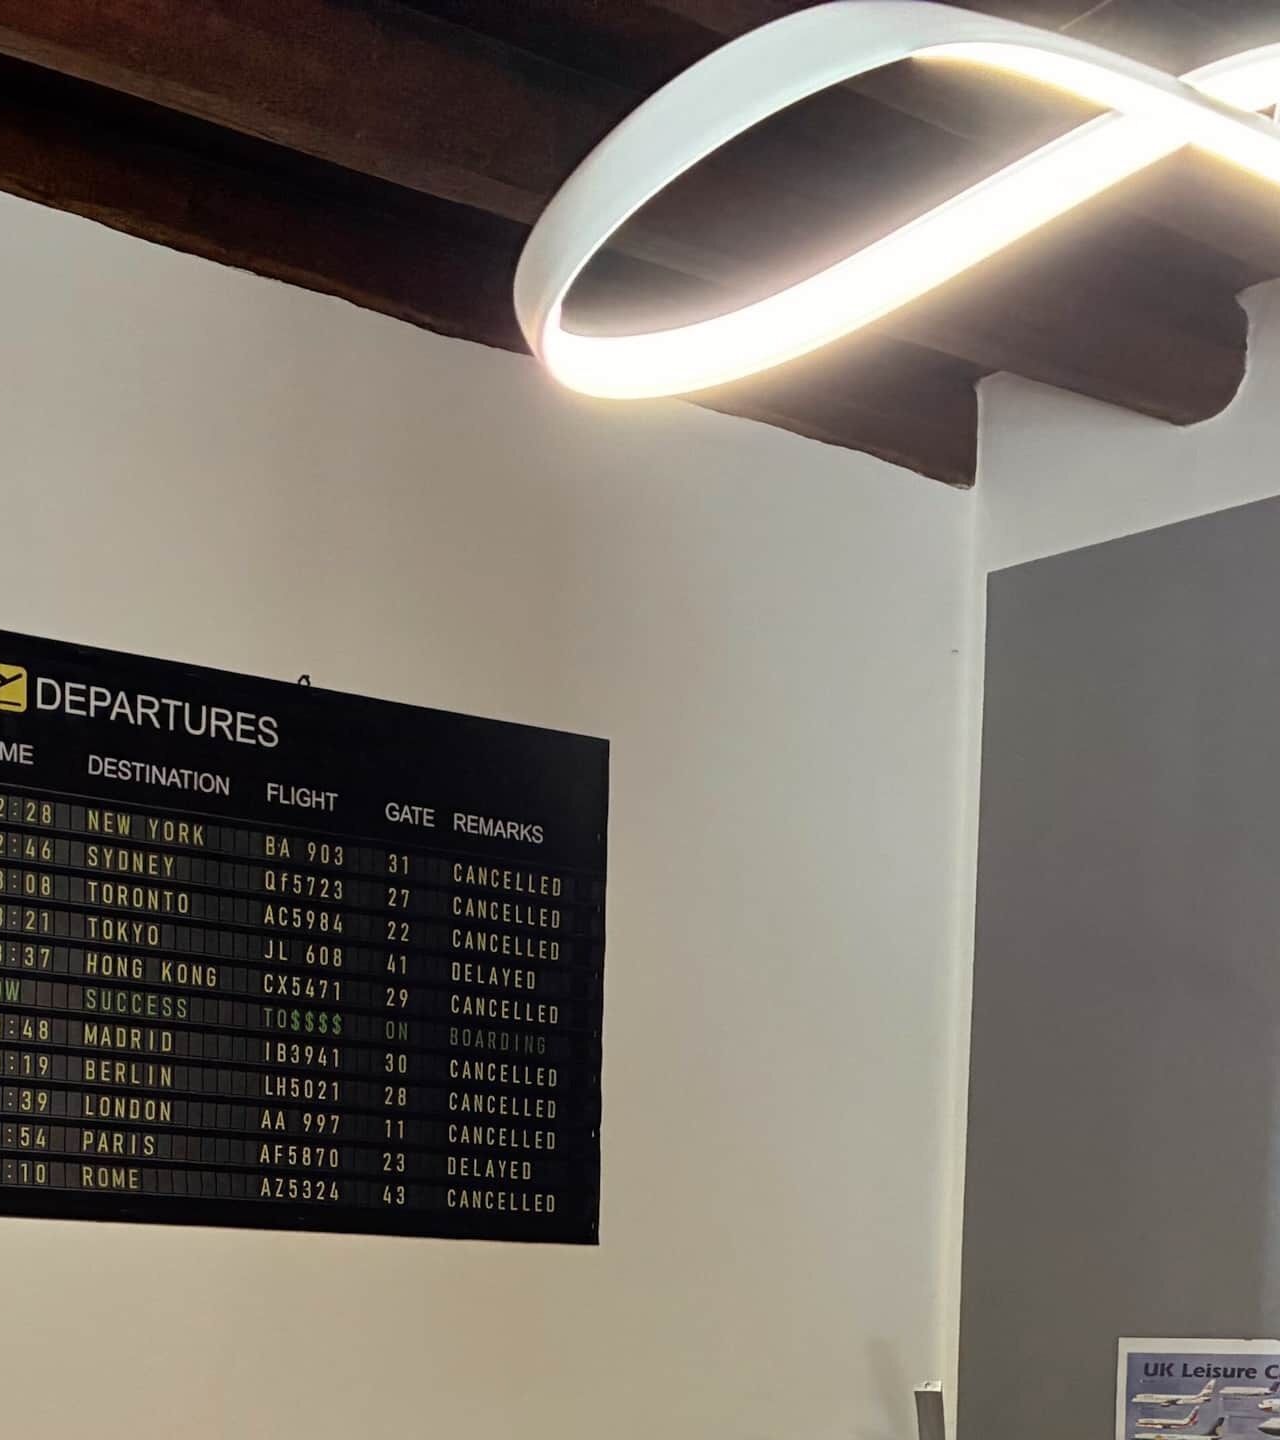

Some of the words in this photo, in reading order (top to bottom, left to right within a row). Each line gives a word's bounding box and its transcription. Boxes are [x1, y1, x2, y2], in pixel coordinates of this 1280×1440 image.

[36, 676, 280, 748] DEPARTURES
[87, 754, 231, 797] DESTINATION
[266, 782, 339, 812] FLIGHT
[384, 802, 436, 828] GATE
[452, 812, 545, 844] REMARKS
[88, 809, 131, 836] NEW
[149, 818, 205, 846] YORK
[265, 835, 291, 858] BA
[307, 842, 344, 866] 903
[388, 853, 410, 875] 31
[453, 862, 561, 897] CANCELLED
[88, 846, 176, 877] SYDNEY
[388, 887, 410, 909] 27
[452, 896, 561, 930] CANCELLED
[88, 881, 190, 914] TORONTO
[263, 904, 343, 934] AC5984
[387, 920, 410, 942] 22
[452, 928, 560, 961] CANCELLED
[88, 917, 159, 946] TOKYO
[263, 940, 289, 961] JL
[306, 946, 343, 968] 608
[386, 953, 408, 975] 41
[451, 961, 537, 991] DELAYED
[86, 952, 144, 979] HONG
[161, 961, 217, 988] KONG
[263, 973, 341, 1001] CX5471
[386, 987, 409, 1009] 29
[450, 994, 559, 1025] CANCELLED
[86, 988, 188, 1019] SUCCESS
[263, 1007, 343, 1036] TO$$$$
[385, 1020, 409, 1041] ON
[449, 1026, 546, 1056] BOARDING
[84, 1023, 172, 1052] MADRID
[265, 1042, 340, 1069] IB3941
[384, 1053, 408, 1074] 30
[449, 1059, 558, 1088] CANCELLED
[85, 1059, 171, 1088] BERLIN
[264, 1075, 340, 1102] LH5021
[384, 1086, 407, 1107] 28
[448, 1091, 557, 1120] CANCELLED
[82, 1130, 155, 1156] PARIS
[259, 1143, 340, 1169] AF5870
[383, 1152, 406, 1173] 23
[447, 1156, 532, 1181] DELAYED
[85, 1095, 171, 1122] LONDON
[260, 1109, 286, 1132] AA
[303, 1112, 341, 1135] 997
[384, 1119, 405, 1140] 11
[448, 1123, 556, 1151] CANCELLED
[82, 1166, 140, 1190] ROME
[260, 1177, 340, 1202] AZ5324
[382, 1185, 406, 1206] 43
[447, 1188, 556, 1214] CANCELLED
[1143, 1362, 1174, 1379] UK
[1181, 1361, 1257, 1381] Leisure
